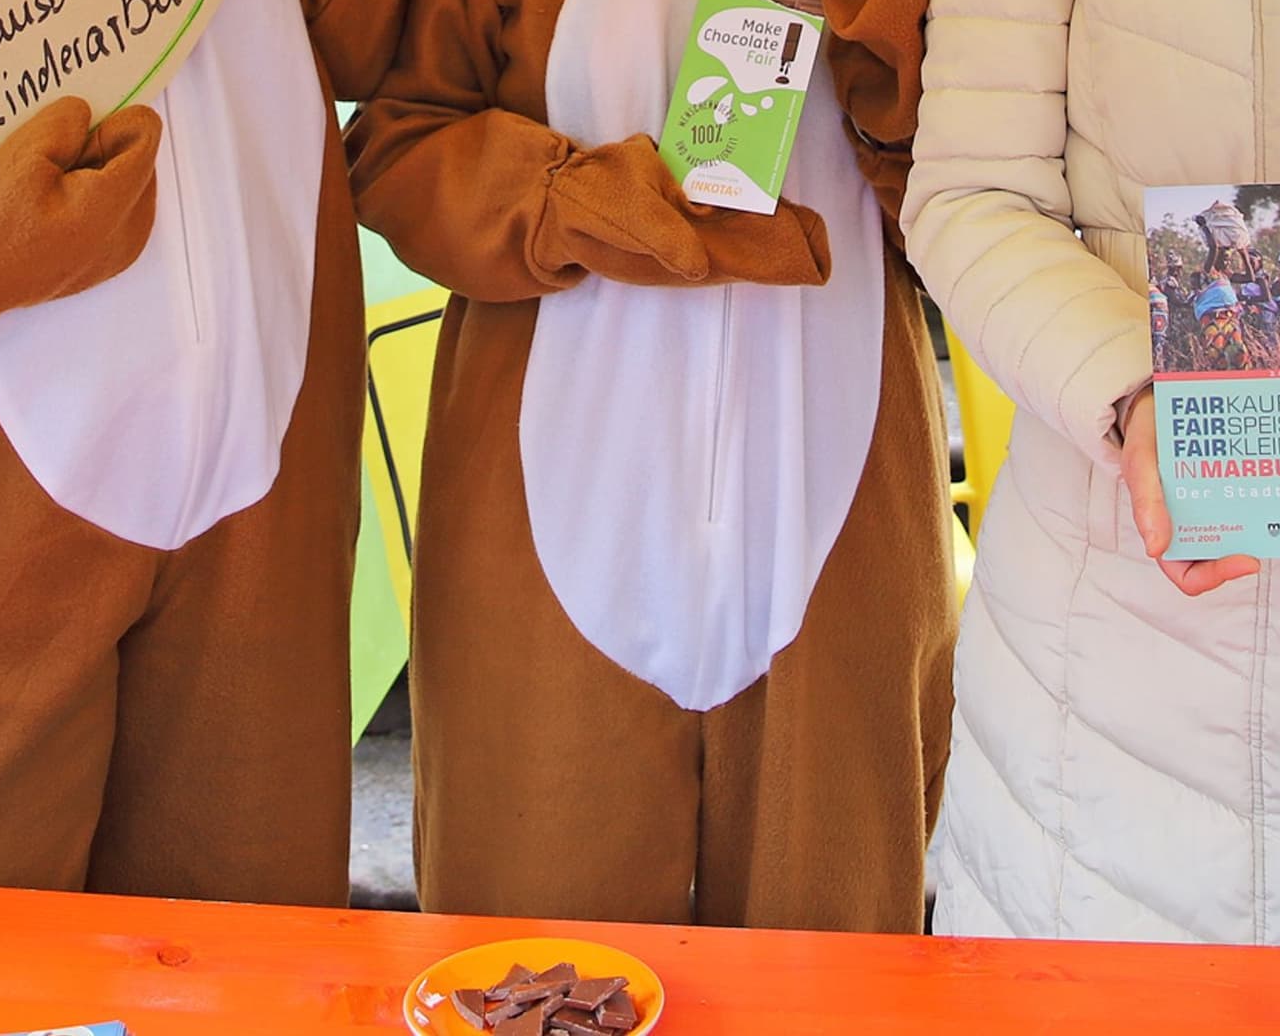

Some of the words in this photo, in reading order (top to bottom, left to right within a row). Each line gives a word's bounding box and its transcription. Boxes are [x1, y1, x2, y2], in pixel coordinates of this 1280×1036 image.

[741, 18, 783, 36] Make
[703, 27, 779, 51] Chocolate
[745, 50, 777, 66] Fair
[691, 124, 723, 145] 100%
[1174, 461, 1197, 479] IN
[1175, 486, 1211, 500] Der
